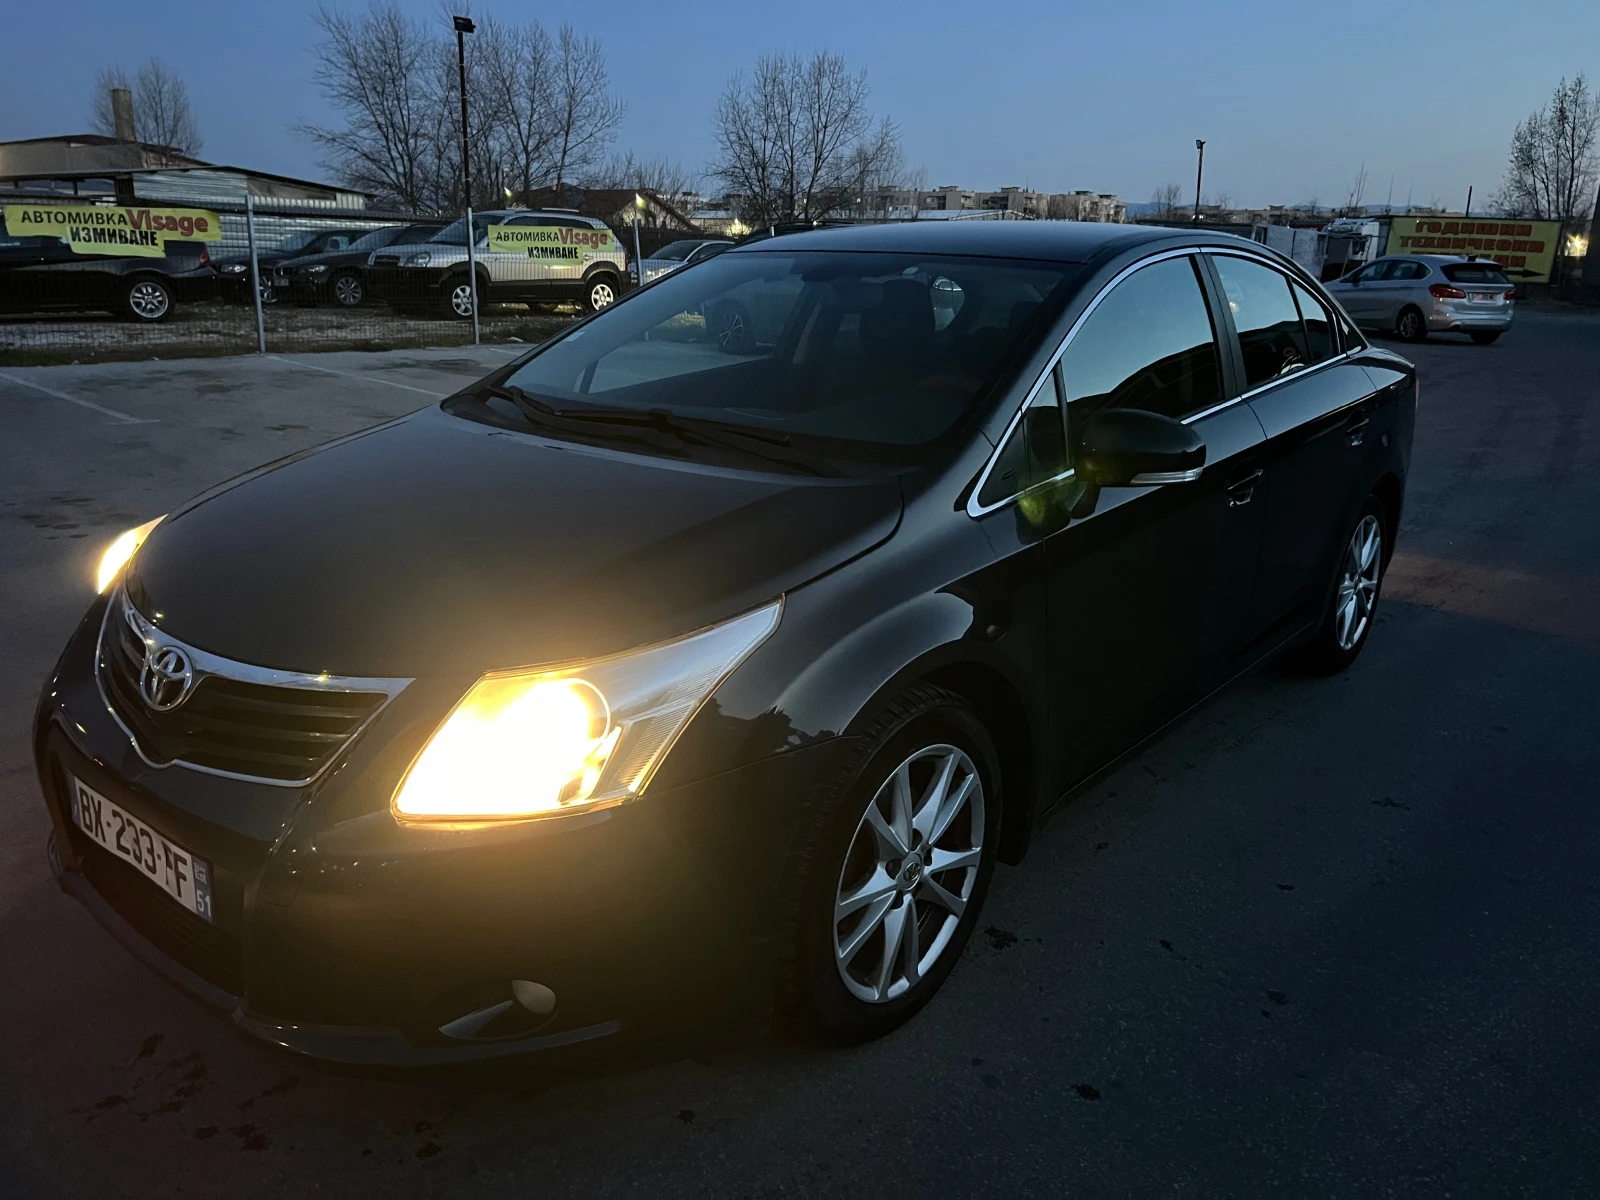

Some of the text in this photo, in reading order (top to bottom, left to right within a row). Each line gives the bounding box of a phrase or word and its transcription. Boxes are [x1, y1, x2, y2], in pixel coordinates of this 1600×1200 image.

[21, 209, 128, 226] АВТОМИВКА
[70, 227, 158, 246] ИЗМИВАНЕ
[496, 231, 560, 242] АВТОМИВКА
[1416, 221, 1532, 236] ГОДИШНИ
[527, 246, 579, 259] ИЗМИВАНЕ
[1400, 236, 1545, 253] ТЕХНИЧЕСКИ
[196, 889, 212, 918] 51
